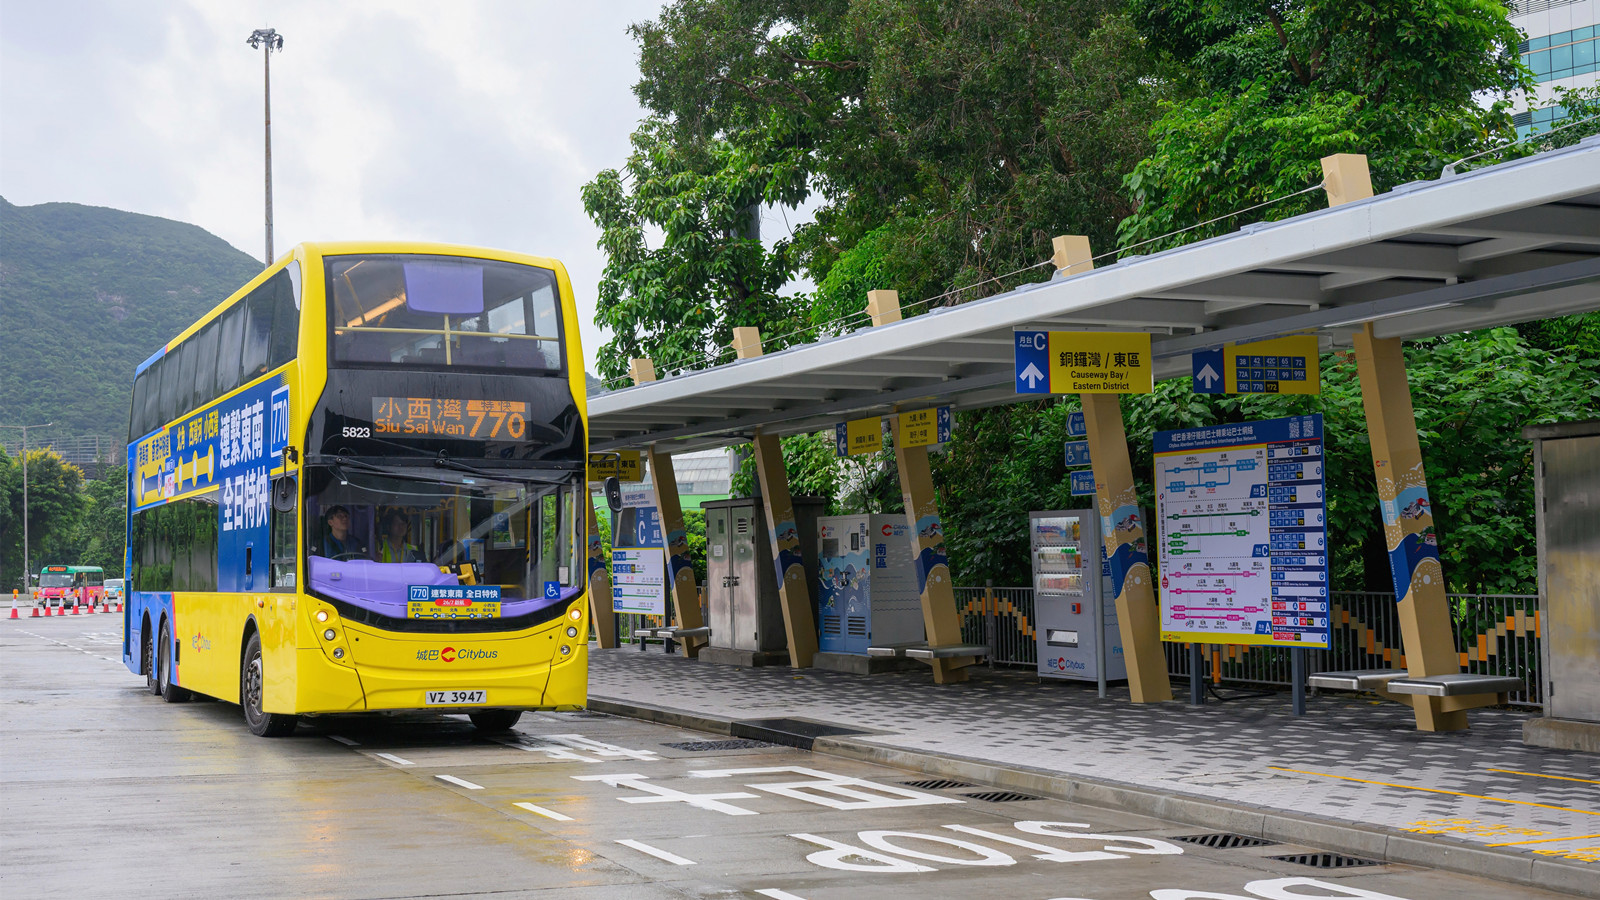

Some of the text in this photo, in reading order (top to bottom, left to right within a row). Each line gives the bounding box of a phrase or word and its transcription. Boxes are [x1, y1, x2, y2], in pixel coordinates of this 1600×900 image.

[1019, 336, 1032, 344] 月台
[1034, 333, 1046, 350] C
[1060, 352, 1101, 368] 銅鑼灣
[1114, 352, 1140, 368] 東區
[1070, 370, 1108, 380] Causeway
[1110, 370, 1124, 380] Bay
[1073, 382, 1130, 390] Eastern District
[378, 397, 462, 420] 小西灣
[481, 400, 512, 412] 特快
[272, 398, 288, 444] 770
[375, 418, 464, 436] Siu Sai Wan
[468, 411, 526, 438] 770
[220, 398, 264, 470] 連繫東南
[342, 426, 370, 438] 5823
[1260, 486, 1266, 496] B
[222, 465, 268, 532] 全日特快
[638, 520, 646, 544] C
[875, 543, 887, 568] 南區
[1262, 545, 1268, 556] C
[412, 588, 426, 598] 770
[431, 589, 498, 599] 連繫東南 全日特快
[1265, 622, 1271, 633] A
[416, 648, 498, 661] 城巴 Citybus
[1065, 660, 1085, 670] Citybus
[429, 691, 483, 703] VZ 3947
[788, 819, 1184, 873] STOP
